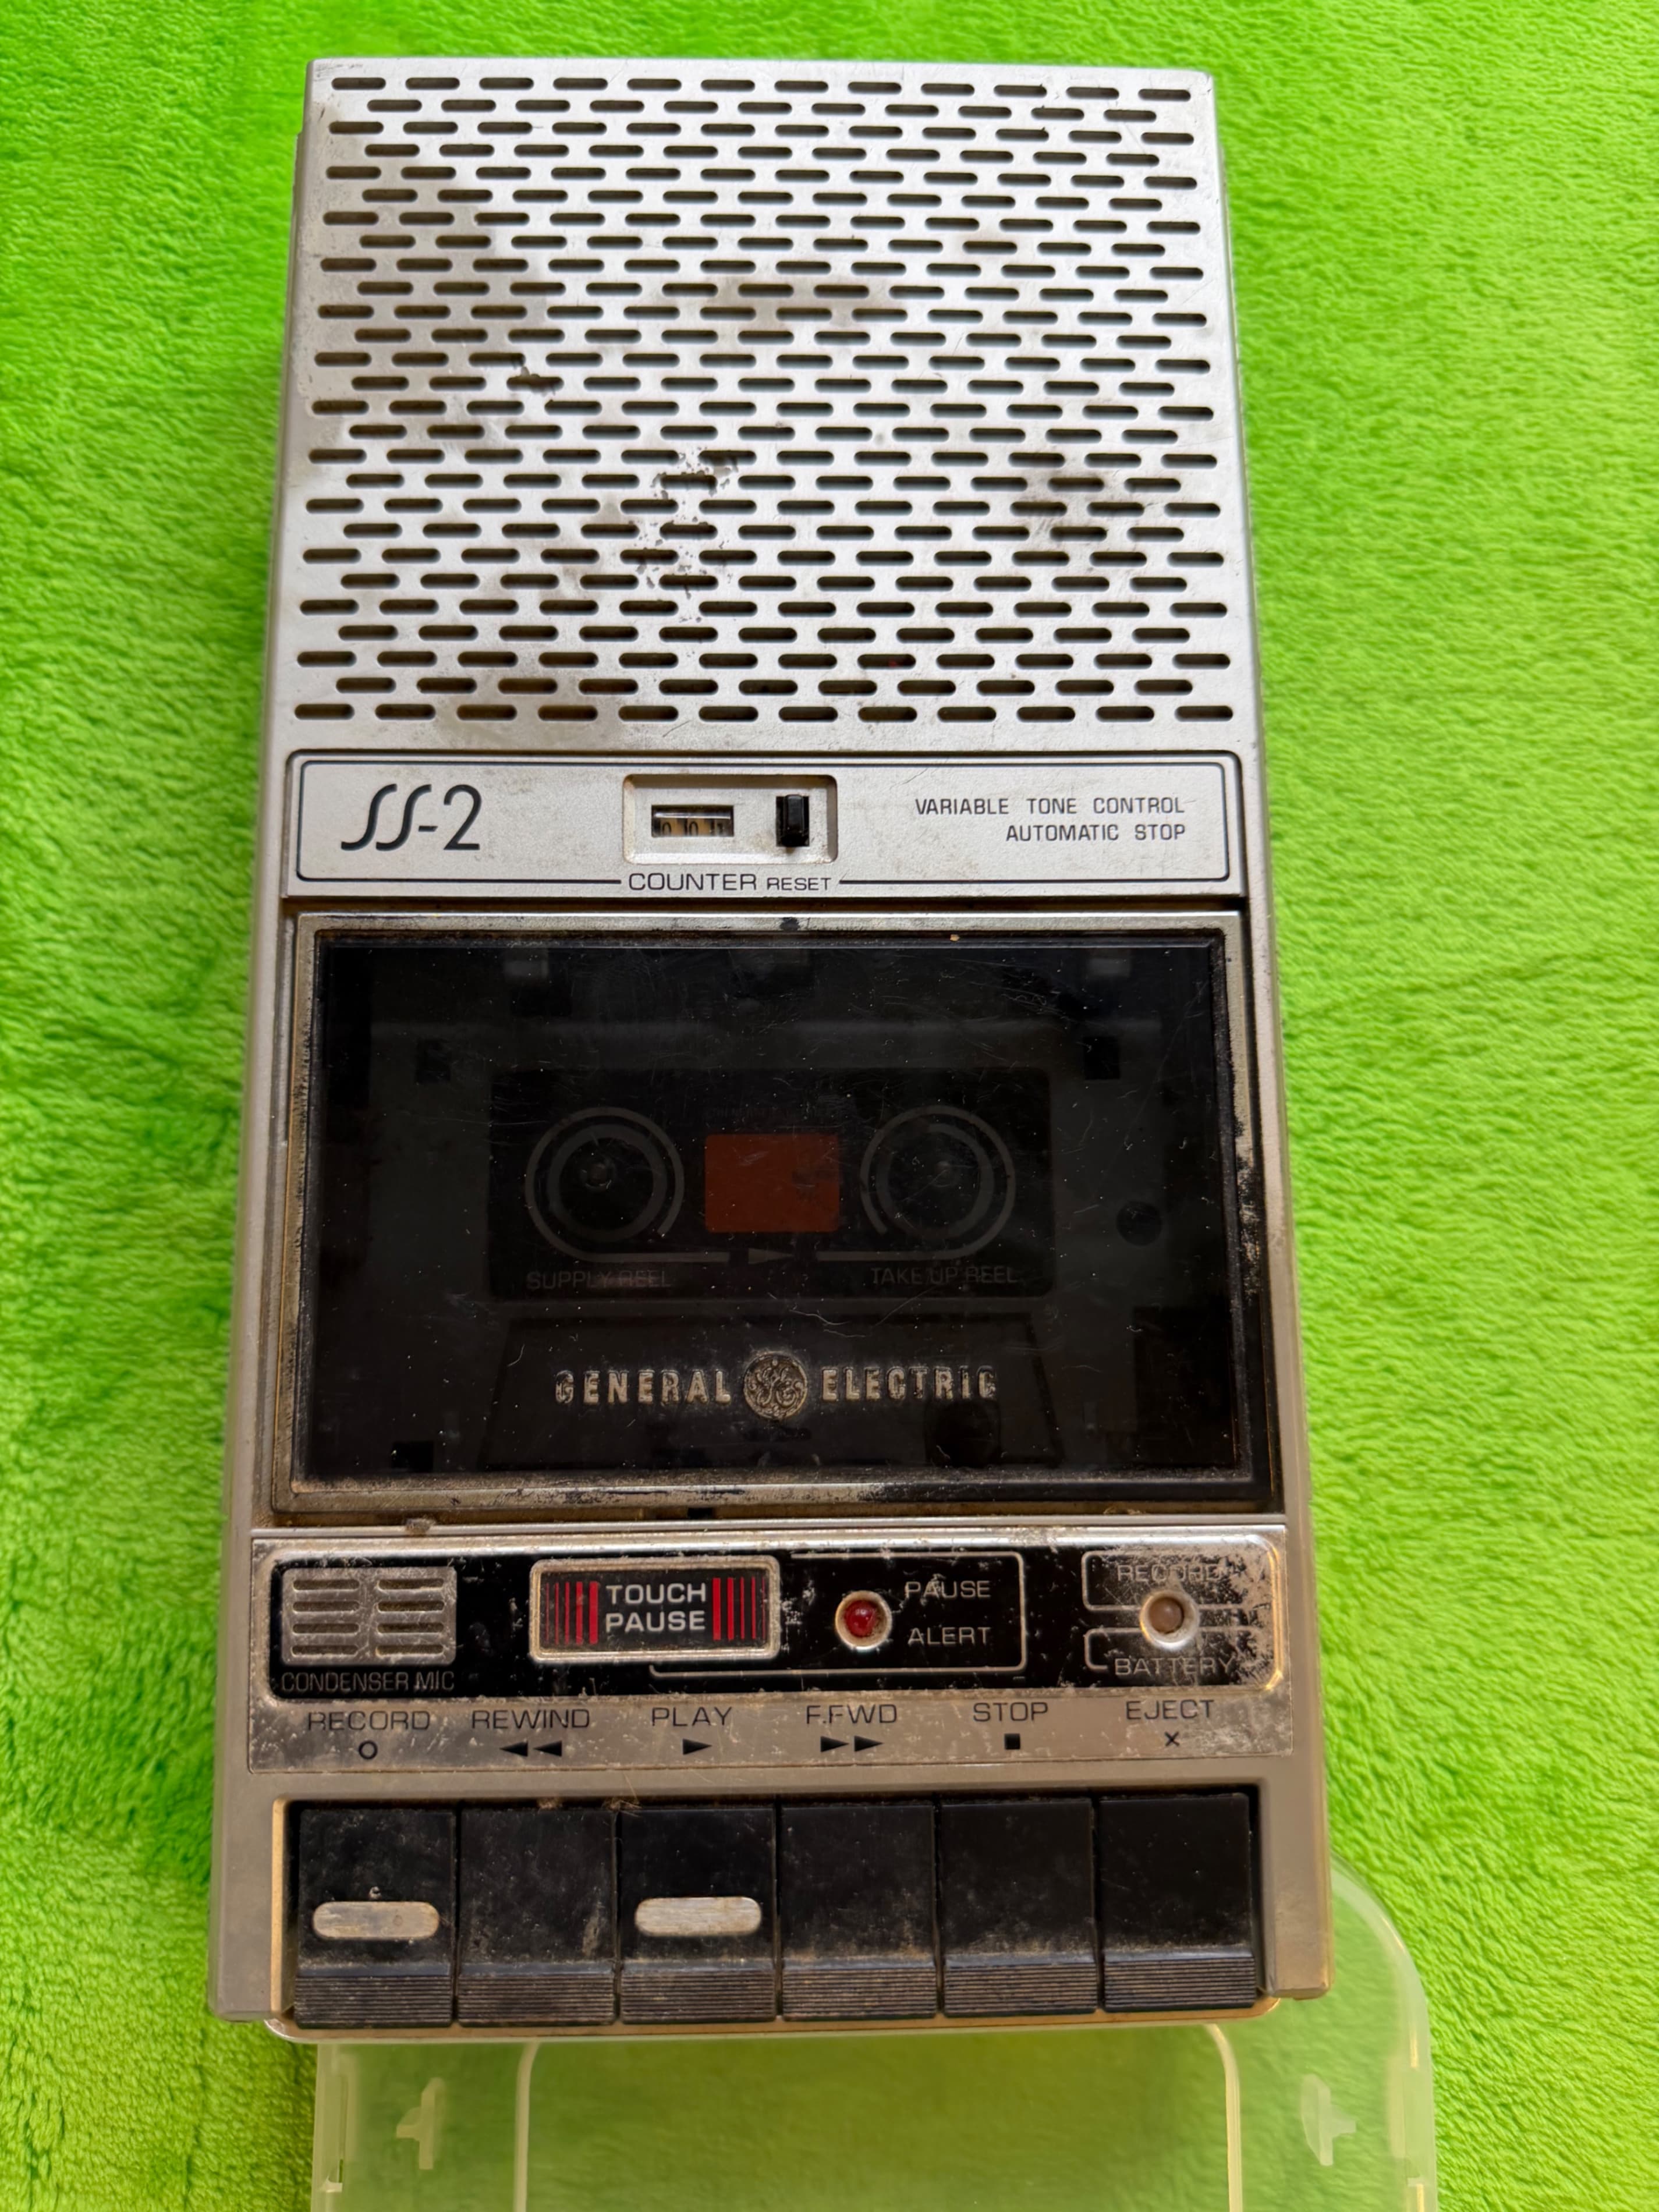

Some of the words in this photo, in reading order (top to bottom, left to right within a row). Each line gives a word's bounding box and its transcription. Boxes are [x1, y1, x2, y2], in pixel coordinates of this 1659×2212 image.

[915, 798, 1010, 815] VARIABLE
[1027, 797, 1077, 814] TONE
[1093, 796, 1185, 814] CONTROL
[1005, 824, 1119, 842] AUTOMATIC
[1134, 823, 1185, 841] STOP
[628, 873, 757, 891] COUNTER
[767, 877, 832, 891] RESET
[526, 1270, 611, 1290] SUPPLY
[871, 1266, 923, 1285] TAKE
[929, 1265, 959, 1285] UP
[964, 1265, 1019, 1284] REEL
[555, 1369, 732, 1405] GENERAL
[821, 1364, 998, 1400] ELECTRIC
[1117, 1564, 1222, 1583] RECORD
[605, 1583, 707, 1605] TOUCH
[905, 1580, 991, 1600] PAUSE
[605, 1611, 706, 1632] PAUSE
[908, 1627, 991, 1646] ALERT
[1114, 1657, 1234, 1676] BATTERY
[281, 1671, 409, 1692] CONDENSER
[414, 1671, 455, 1692] MIC
[472, 1708, 590, 1729] REWIND
[651, 1706, 733, 1727] PLAY
[806, 1703, 897, 1725] F.FWD
[973, 1701, 1048, 1722] STOP
[1126, 1699, 1215, 1720] EJECT
[307, 1710, 431, 1731] RECORD
